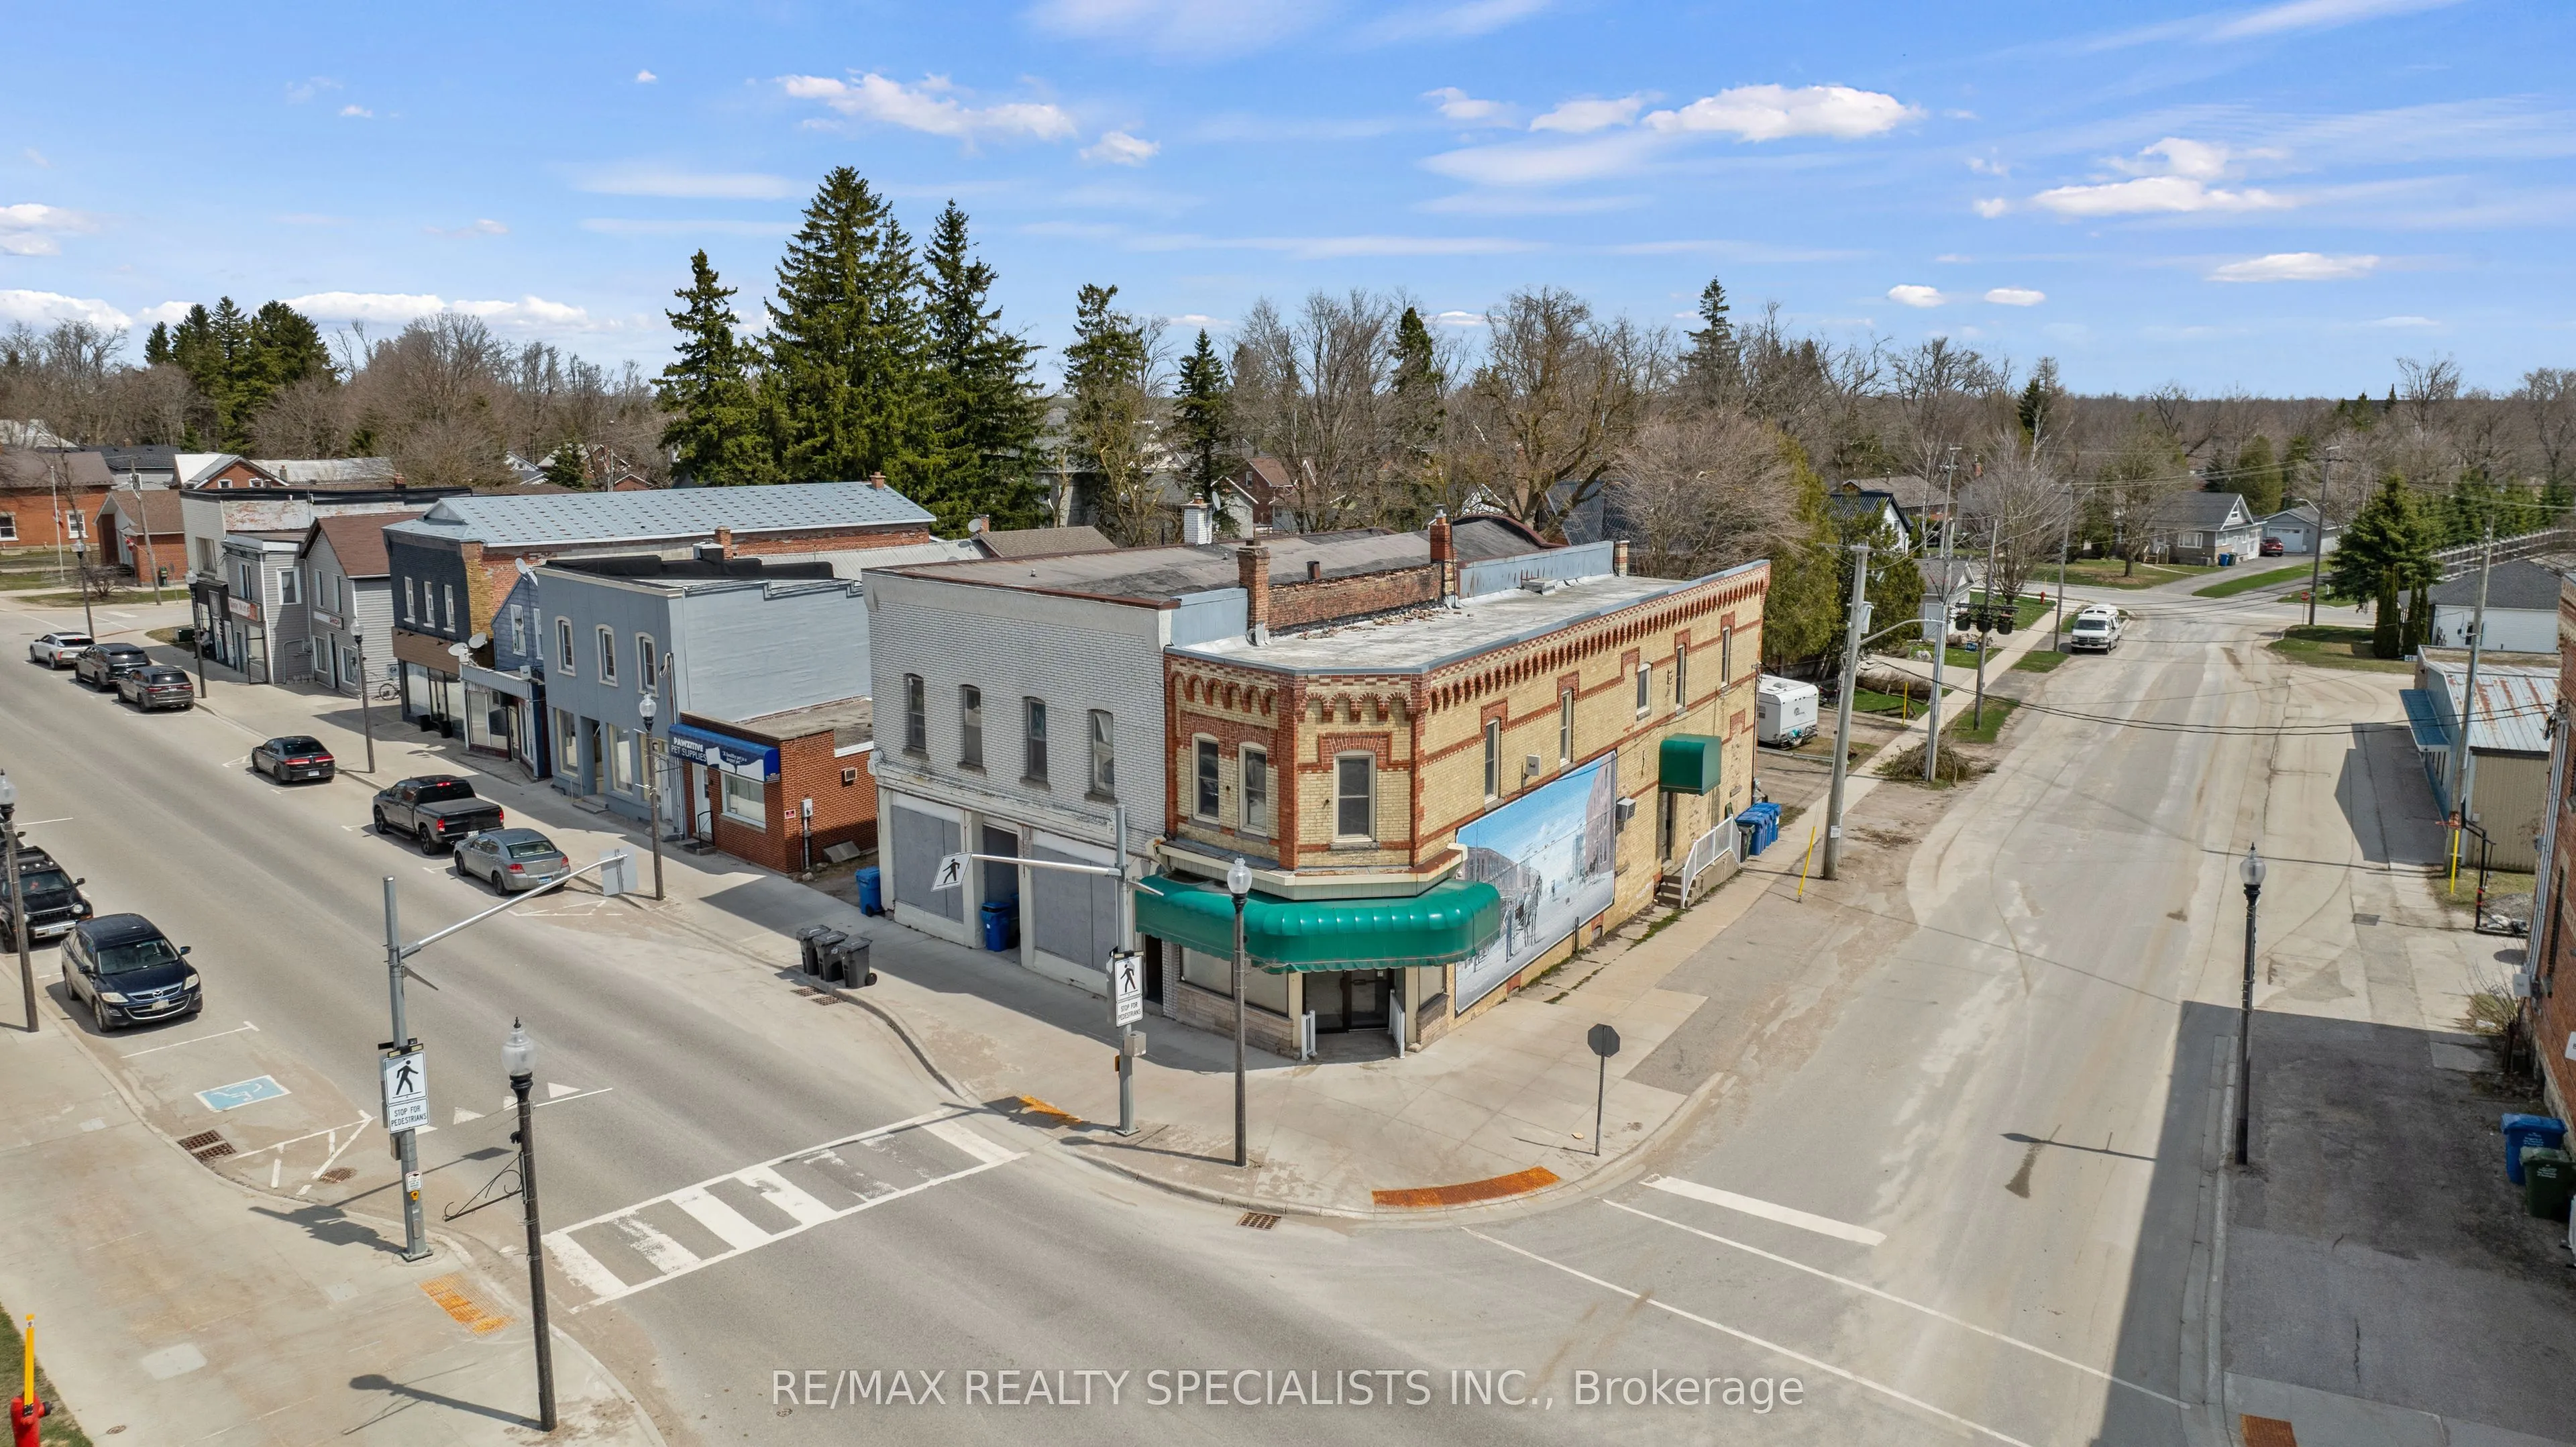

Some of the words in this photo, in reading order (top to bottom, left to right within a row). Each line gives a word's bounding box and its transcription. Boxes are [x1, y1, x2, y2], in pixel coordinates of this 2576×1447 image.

[674, 737, 703, 752] PAWZITIVE
[671, 745, 681, 754] PET
[682, 748, 707, 762] SUPPLIES
[1121, 1004, 1130, 1012] STOP
[394, 1108, 407, 1117] STOP
[411, 1105, 421, 1114] FOR
[391, 1113, 427, 1127] PEDESTRIANS
